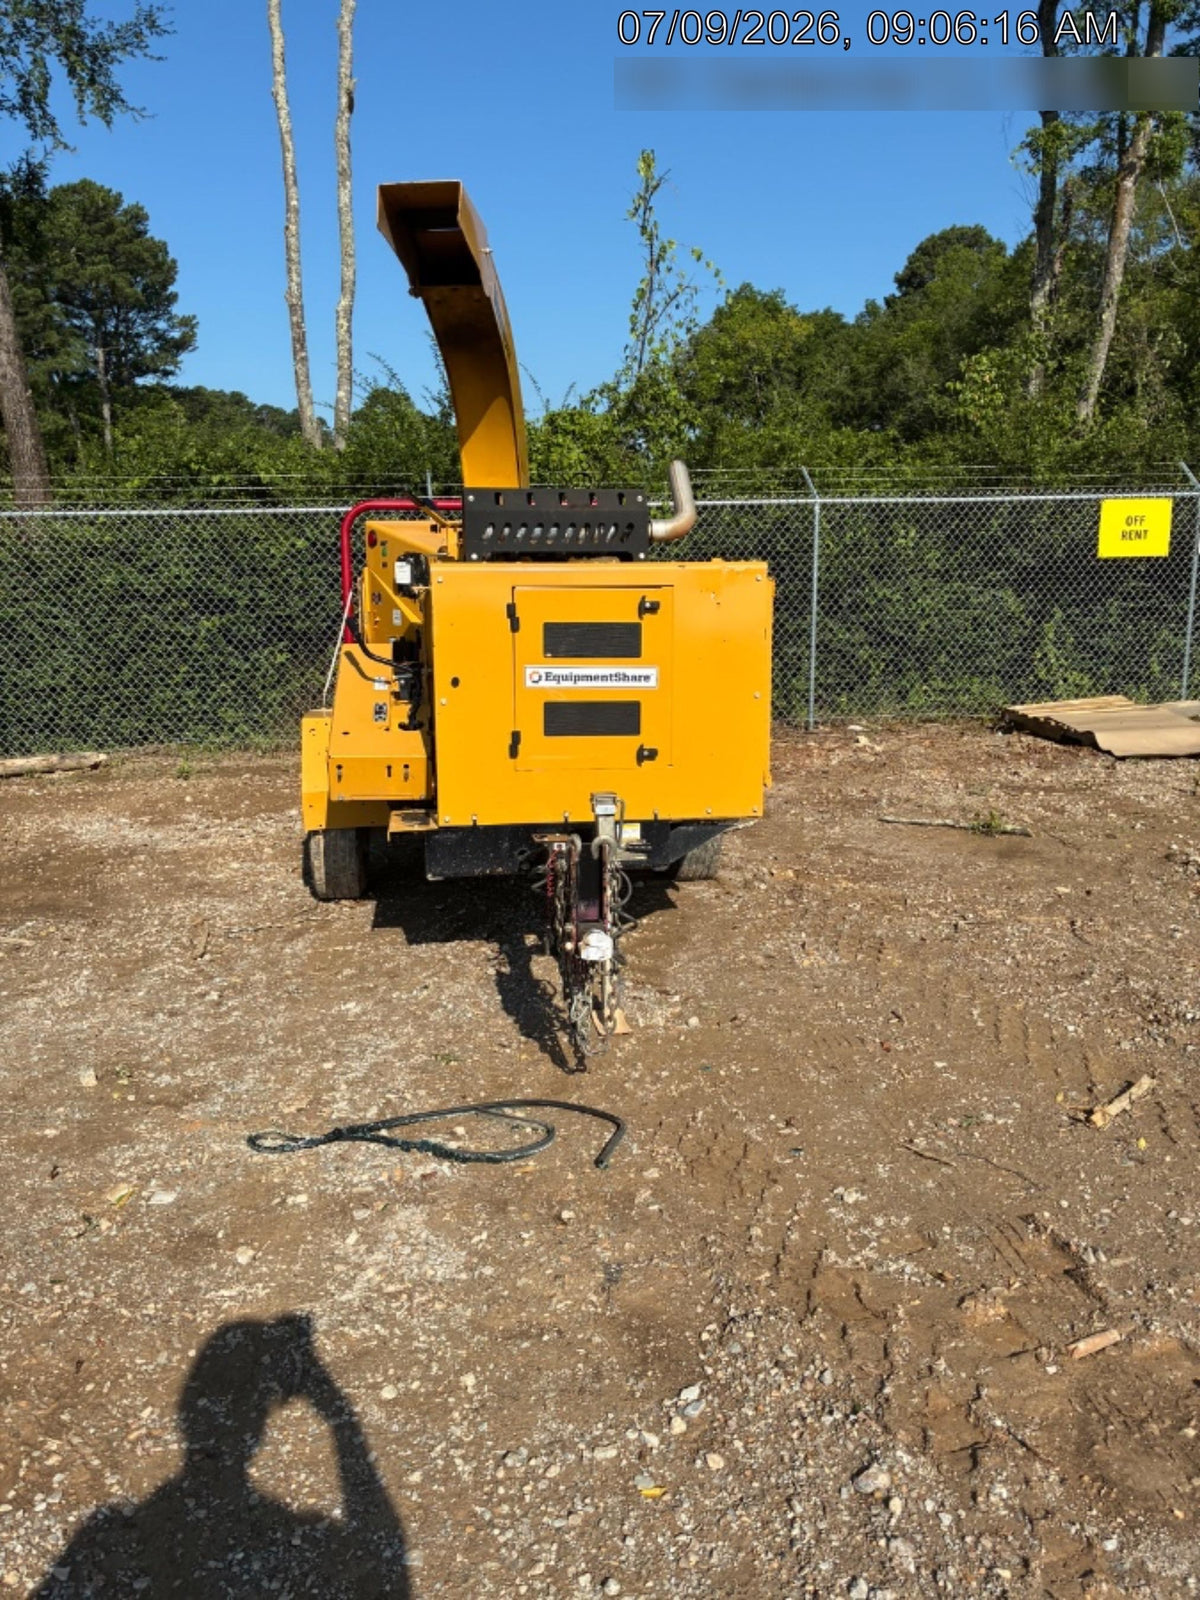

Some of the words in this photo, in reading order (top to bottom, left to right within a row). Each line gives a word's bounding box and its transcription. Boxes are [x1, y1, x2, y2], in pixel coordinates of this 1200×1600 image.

[1125, 515, 1146, 526] OFF
[1121, 529, 1149, 541] RENT
[544, 671, 651, 684] EquipmentShare
